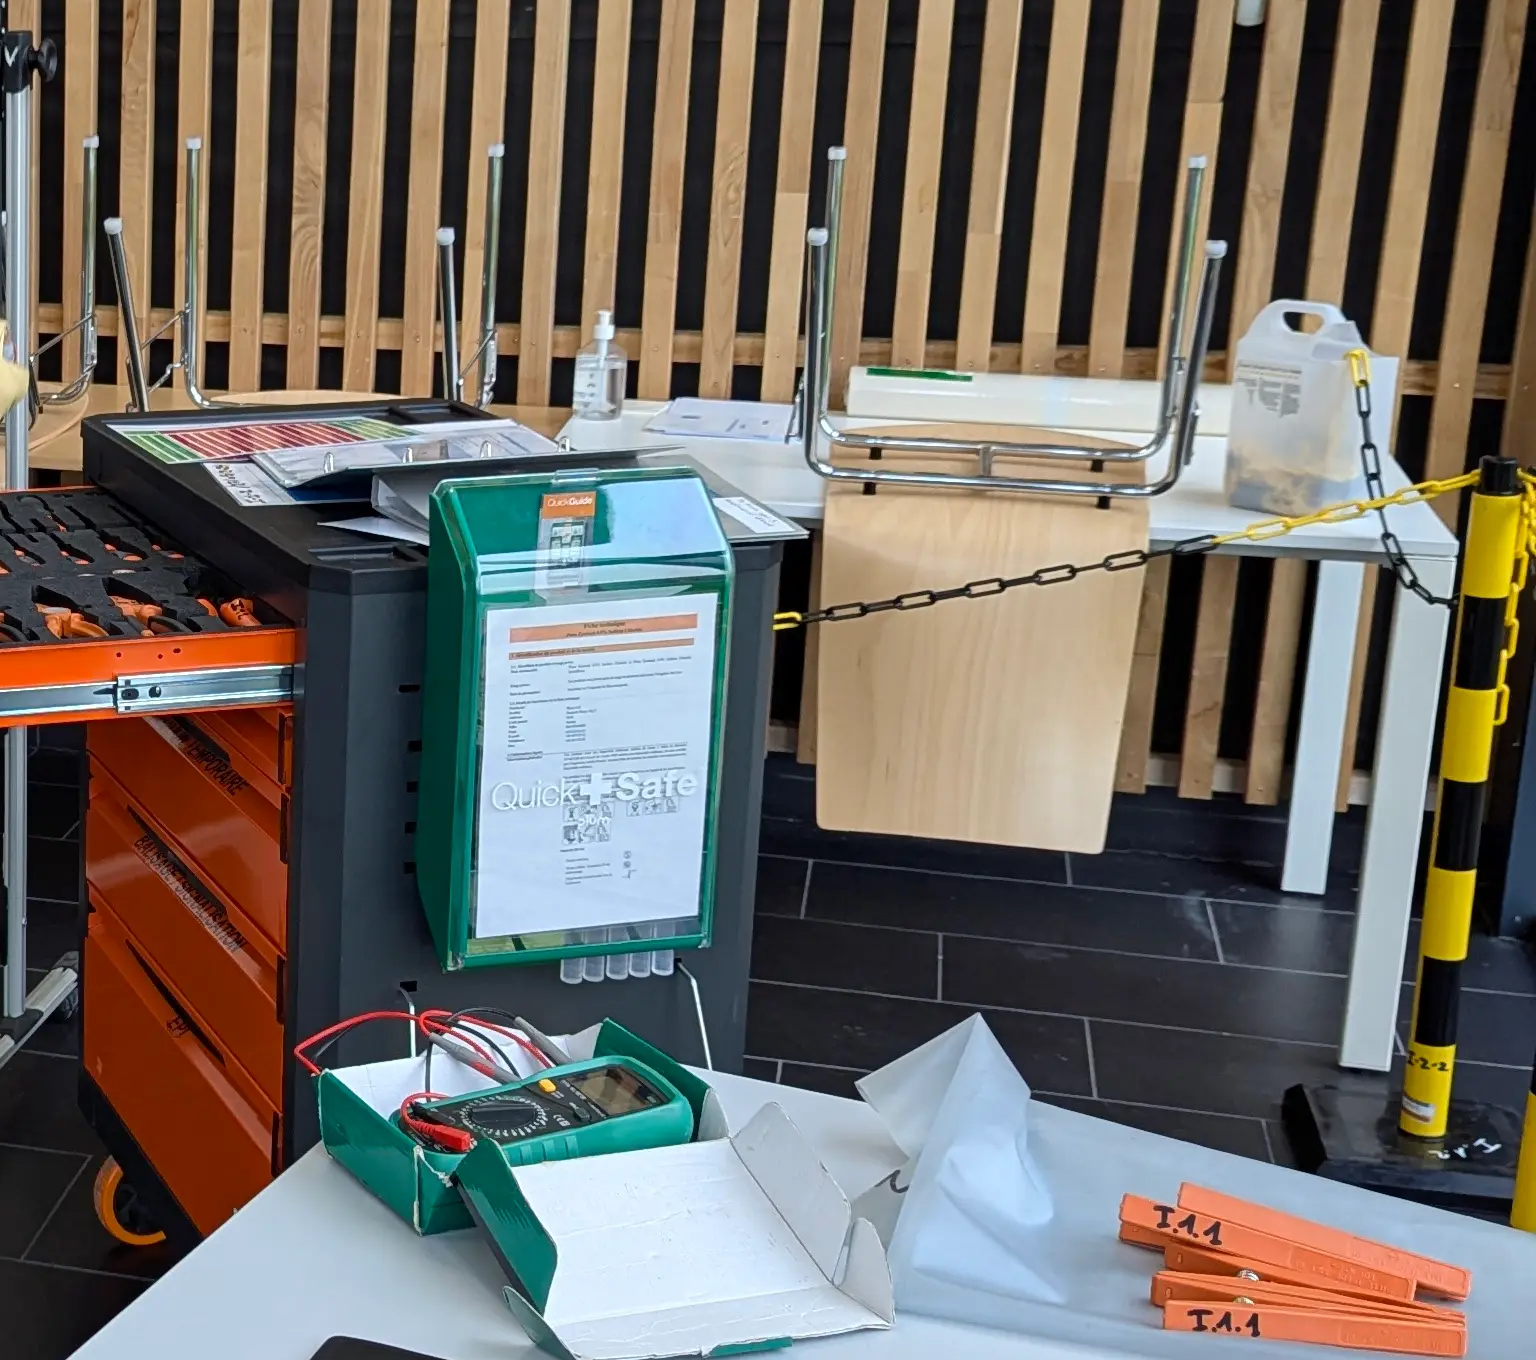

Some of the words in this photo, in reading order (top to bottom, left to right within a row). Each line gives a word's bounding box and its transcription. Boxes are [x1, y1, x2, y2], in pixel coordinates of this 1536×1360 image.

[186, 741, 249, 796] TEMPORAIRE
[491, 776, 579, 811] Quick
[615, 770, 699, 802] Safe
[132, 834, 181, 882] BALISAGE
[171, 878, 248, 955] SIGNALISATION
[1153, 1205, 1223, 1245] I.1.1
[1188, 1309, 1261, 1337] I.1.1
